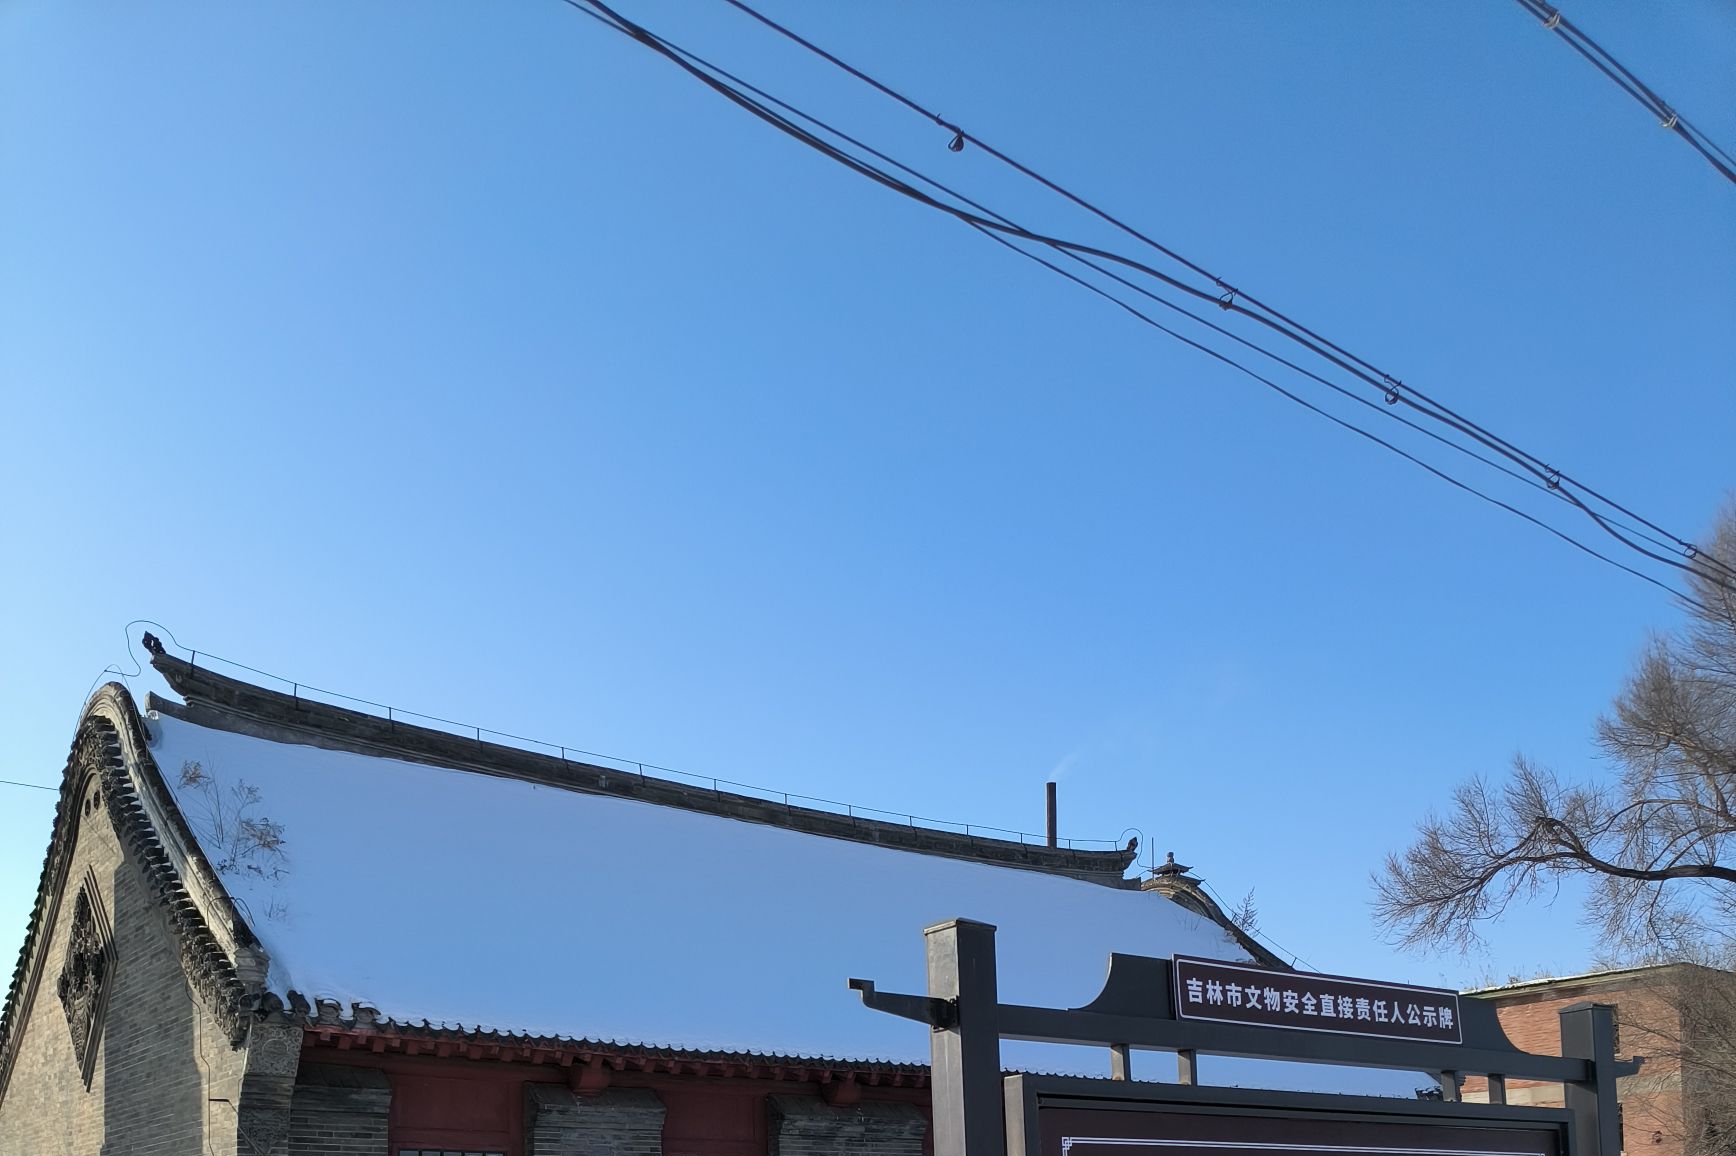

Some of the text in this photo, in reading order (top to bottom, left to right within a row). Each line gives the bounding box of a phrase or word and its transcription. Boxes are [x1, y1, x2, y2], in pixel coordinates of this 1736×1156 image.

[1186, 977, 1454, 1030] 吉林市文物安全直接责任人公示牌
